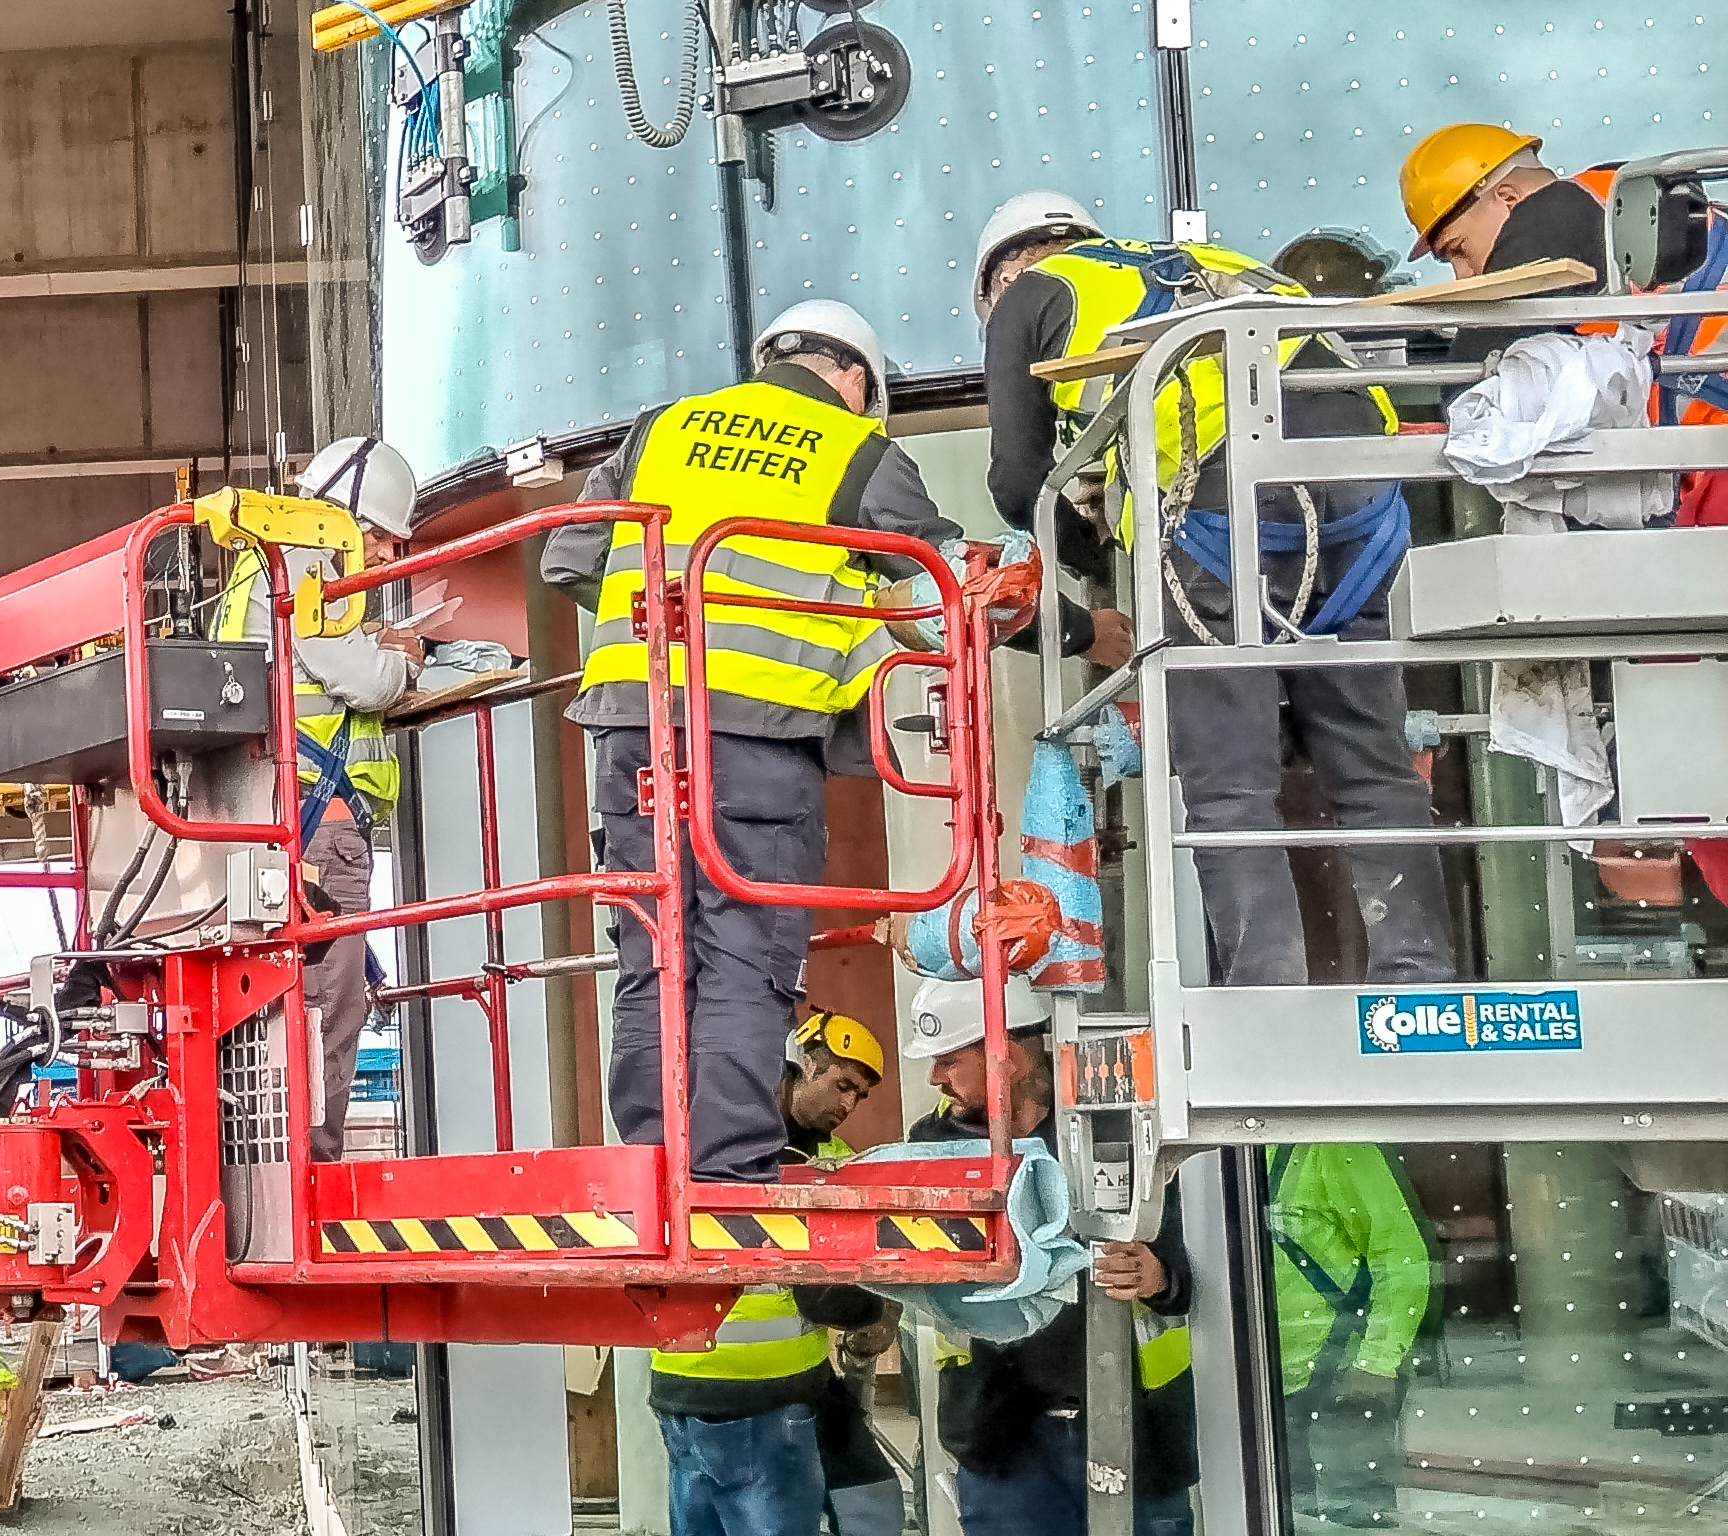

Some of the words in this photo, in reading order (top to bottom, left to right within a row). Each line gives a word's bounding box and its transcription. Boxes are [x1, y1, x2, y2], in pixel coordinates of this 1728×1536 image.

[680, 409, 824, 454] FRENER
[685, 442, 808, 485] REIFER
[1364, 995, 1462, 1052] Collé
[1479, 1002, 1576, 1023] RENTAL
[1481, 1024, 1500, 1042] &
[1502, 1022, 1578, 1042] SALES
